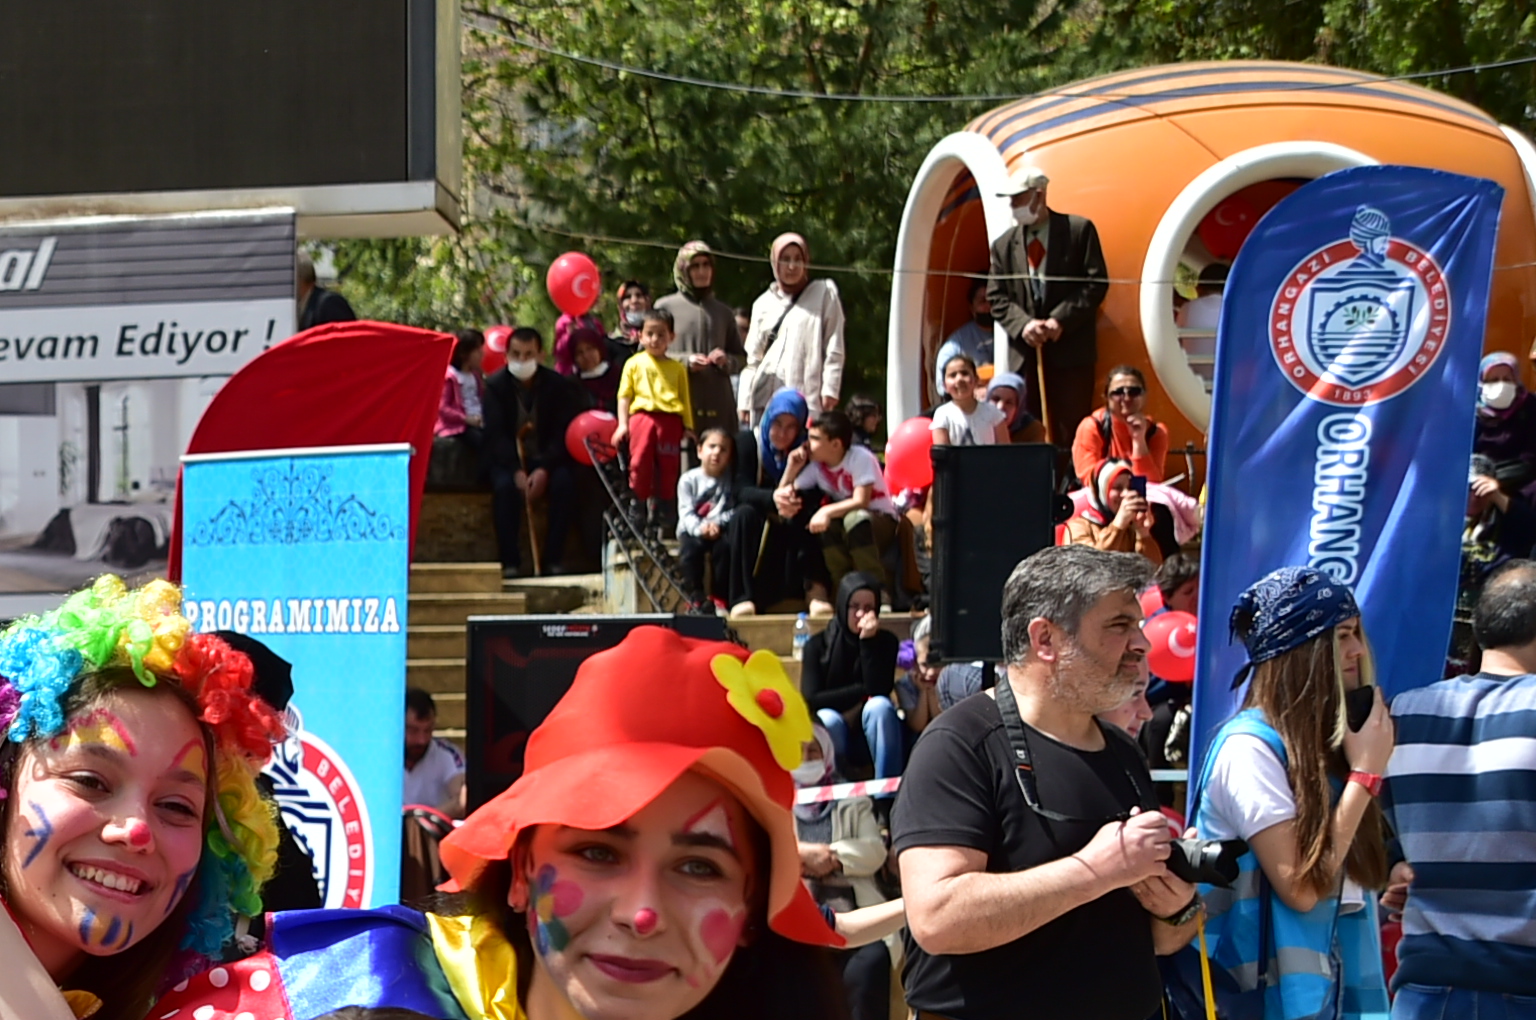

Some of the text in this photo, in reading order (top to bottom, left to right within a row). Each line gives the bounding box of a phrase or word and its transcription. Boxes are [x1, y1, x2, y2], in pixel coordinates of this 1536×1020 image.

[116, 321, 250, 366] Ediyor
[1308, 412, 1373, 589] ORHANG
[184, 597, 401, 634] PROGRAMIMIZA
